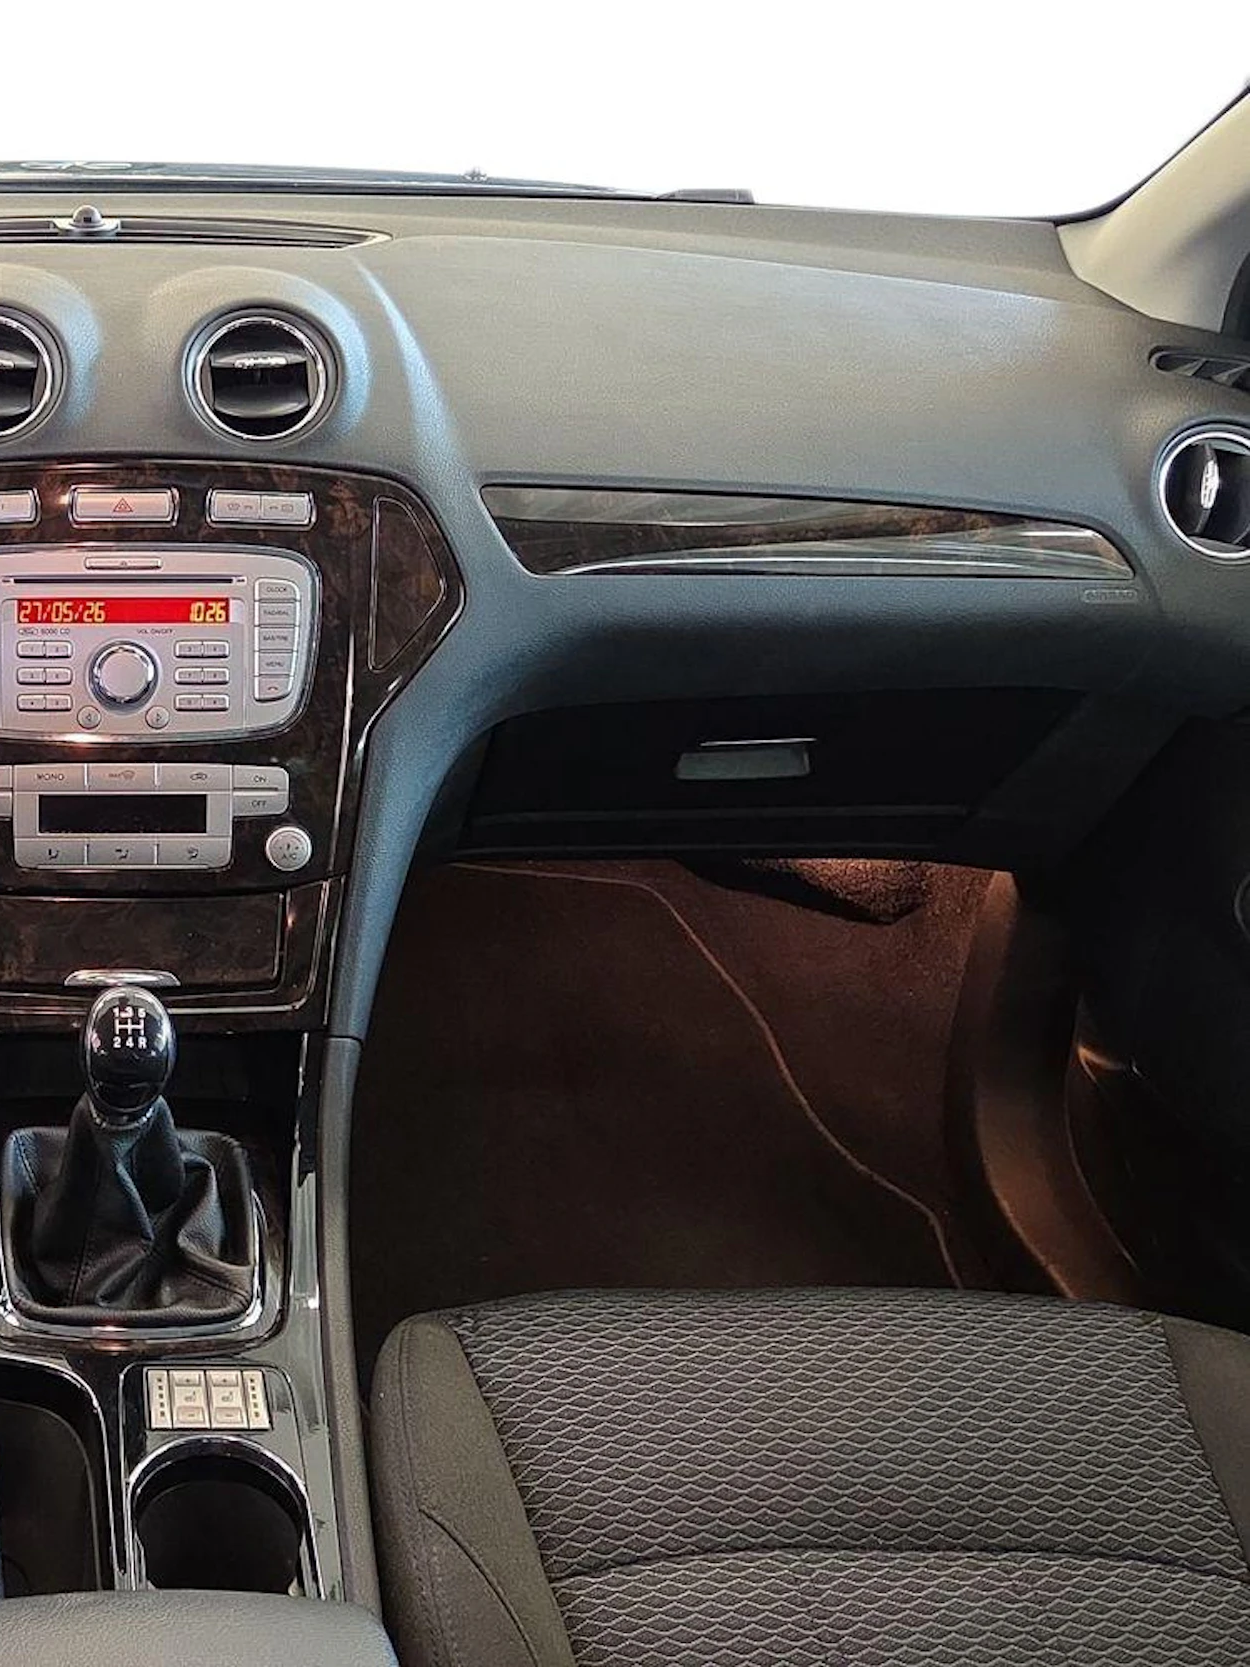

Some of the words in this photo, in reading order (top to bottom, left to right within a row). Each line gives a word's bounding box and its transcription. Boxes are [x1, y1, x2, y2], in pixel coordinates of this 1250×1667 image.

[19, 601, 106, 623] 27/05/26
[36, 773, 65, 781] MONO
[253, 775, 267, 783] ON
[251, 799, 267, 807] OFF
[113, 1007, 120, 1018] 1
[125, 1006, 134, 1018] 3
[137, 1008, 146, 1018] 5
[113, 1036, 121, 1049] 2
[125, 1036, 134, 1049] 4
[137, 1036, 147, 1049] R
